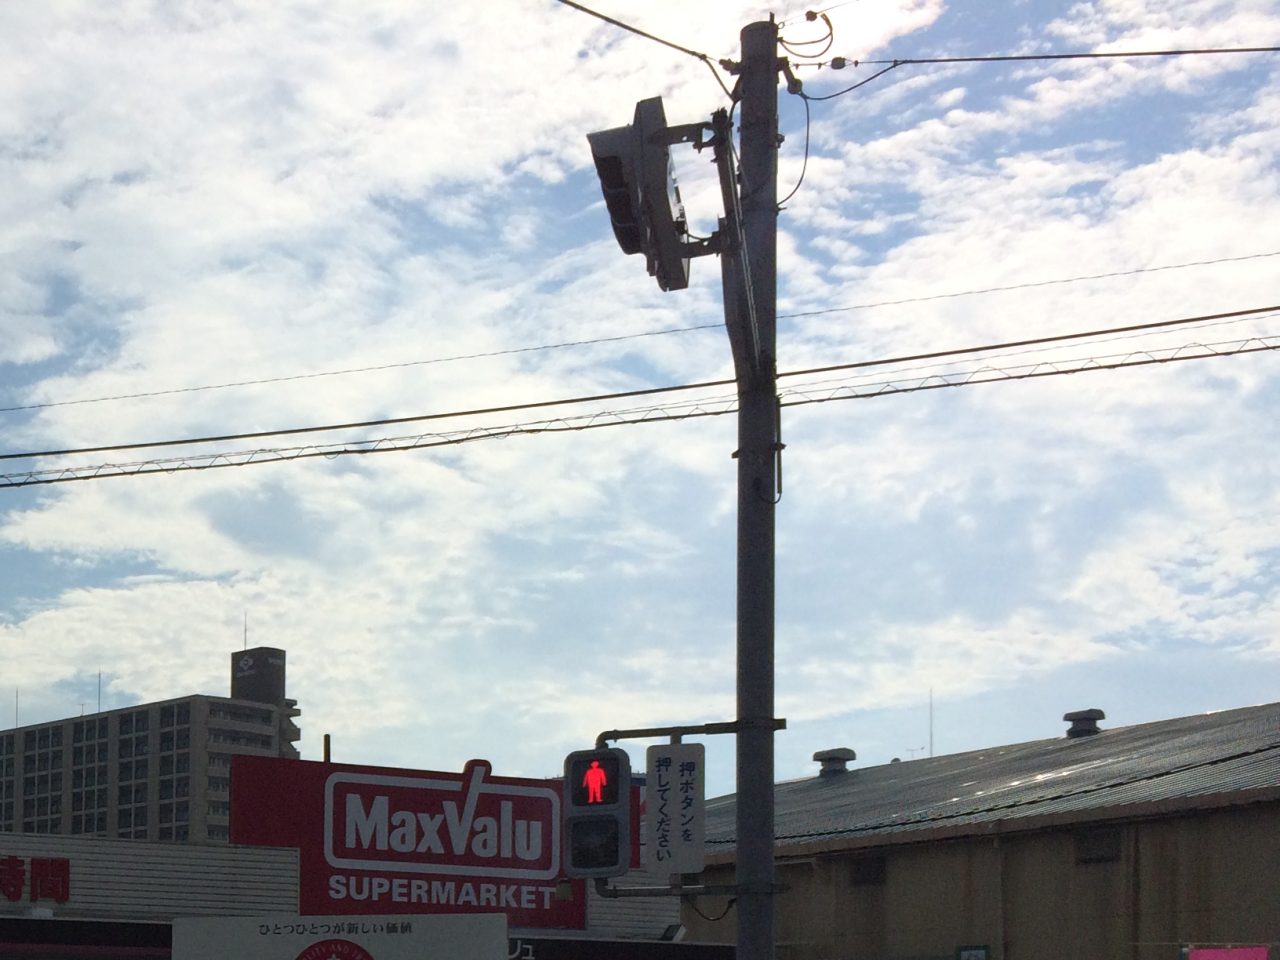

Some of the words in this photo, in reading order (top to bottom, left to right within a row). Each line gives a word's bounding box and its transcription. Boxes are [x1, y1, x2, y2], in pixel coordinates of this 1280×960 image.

[345, 766, 542, 861] MaxValu
[656, 757, 672, 861] 押してください
[680, 762, 696, 842] 押ボタンを
[259, 922, 412, 935] ひとつひとつが新しい価値
[328, 875, 557, 910] SUPERMARKET
